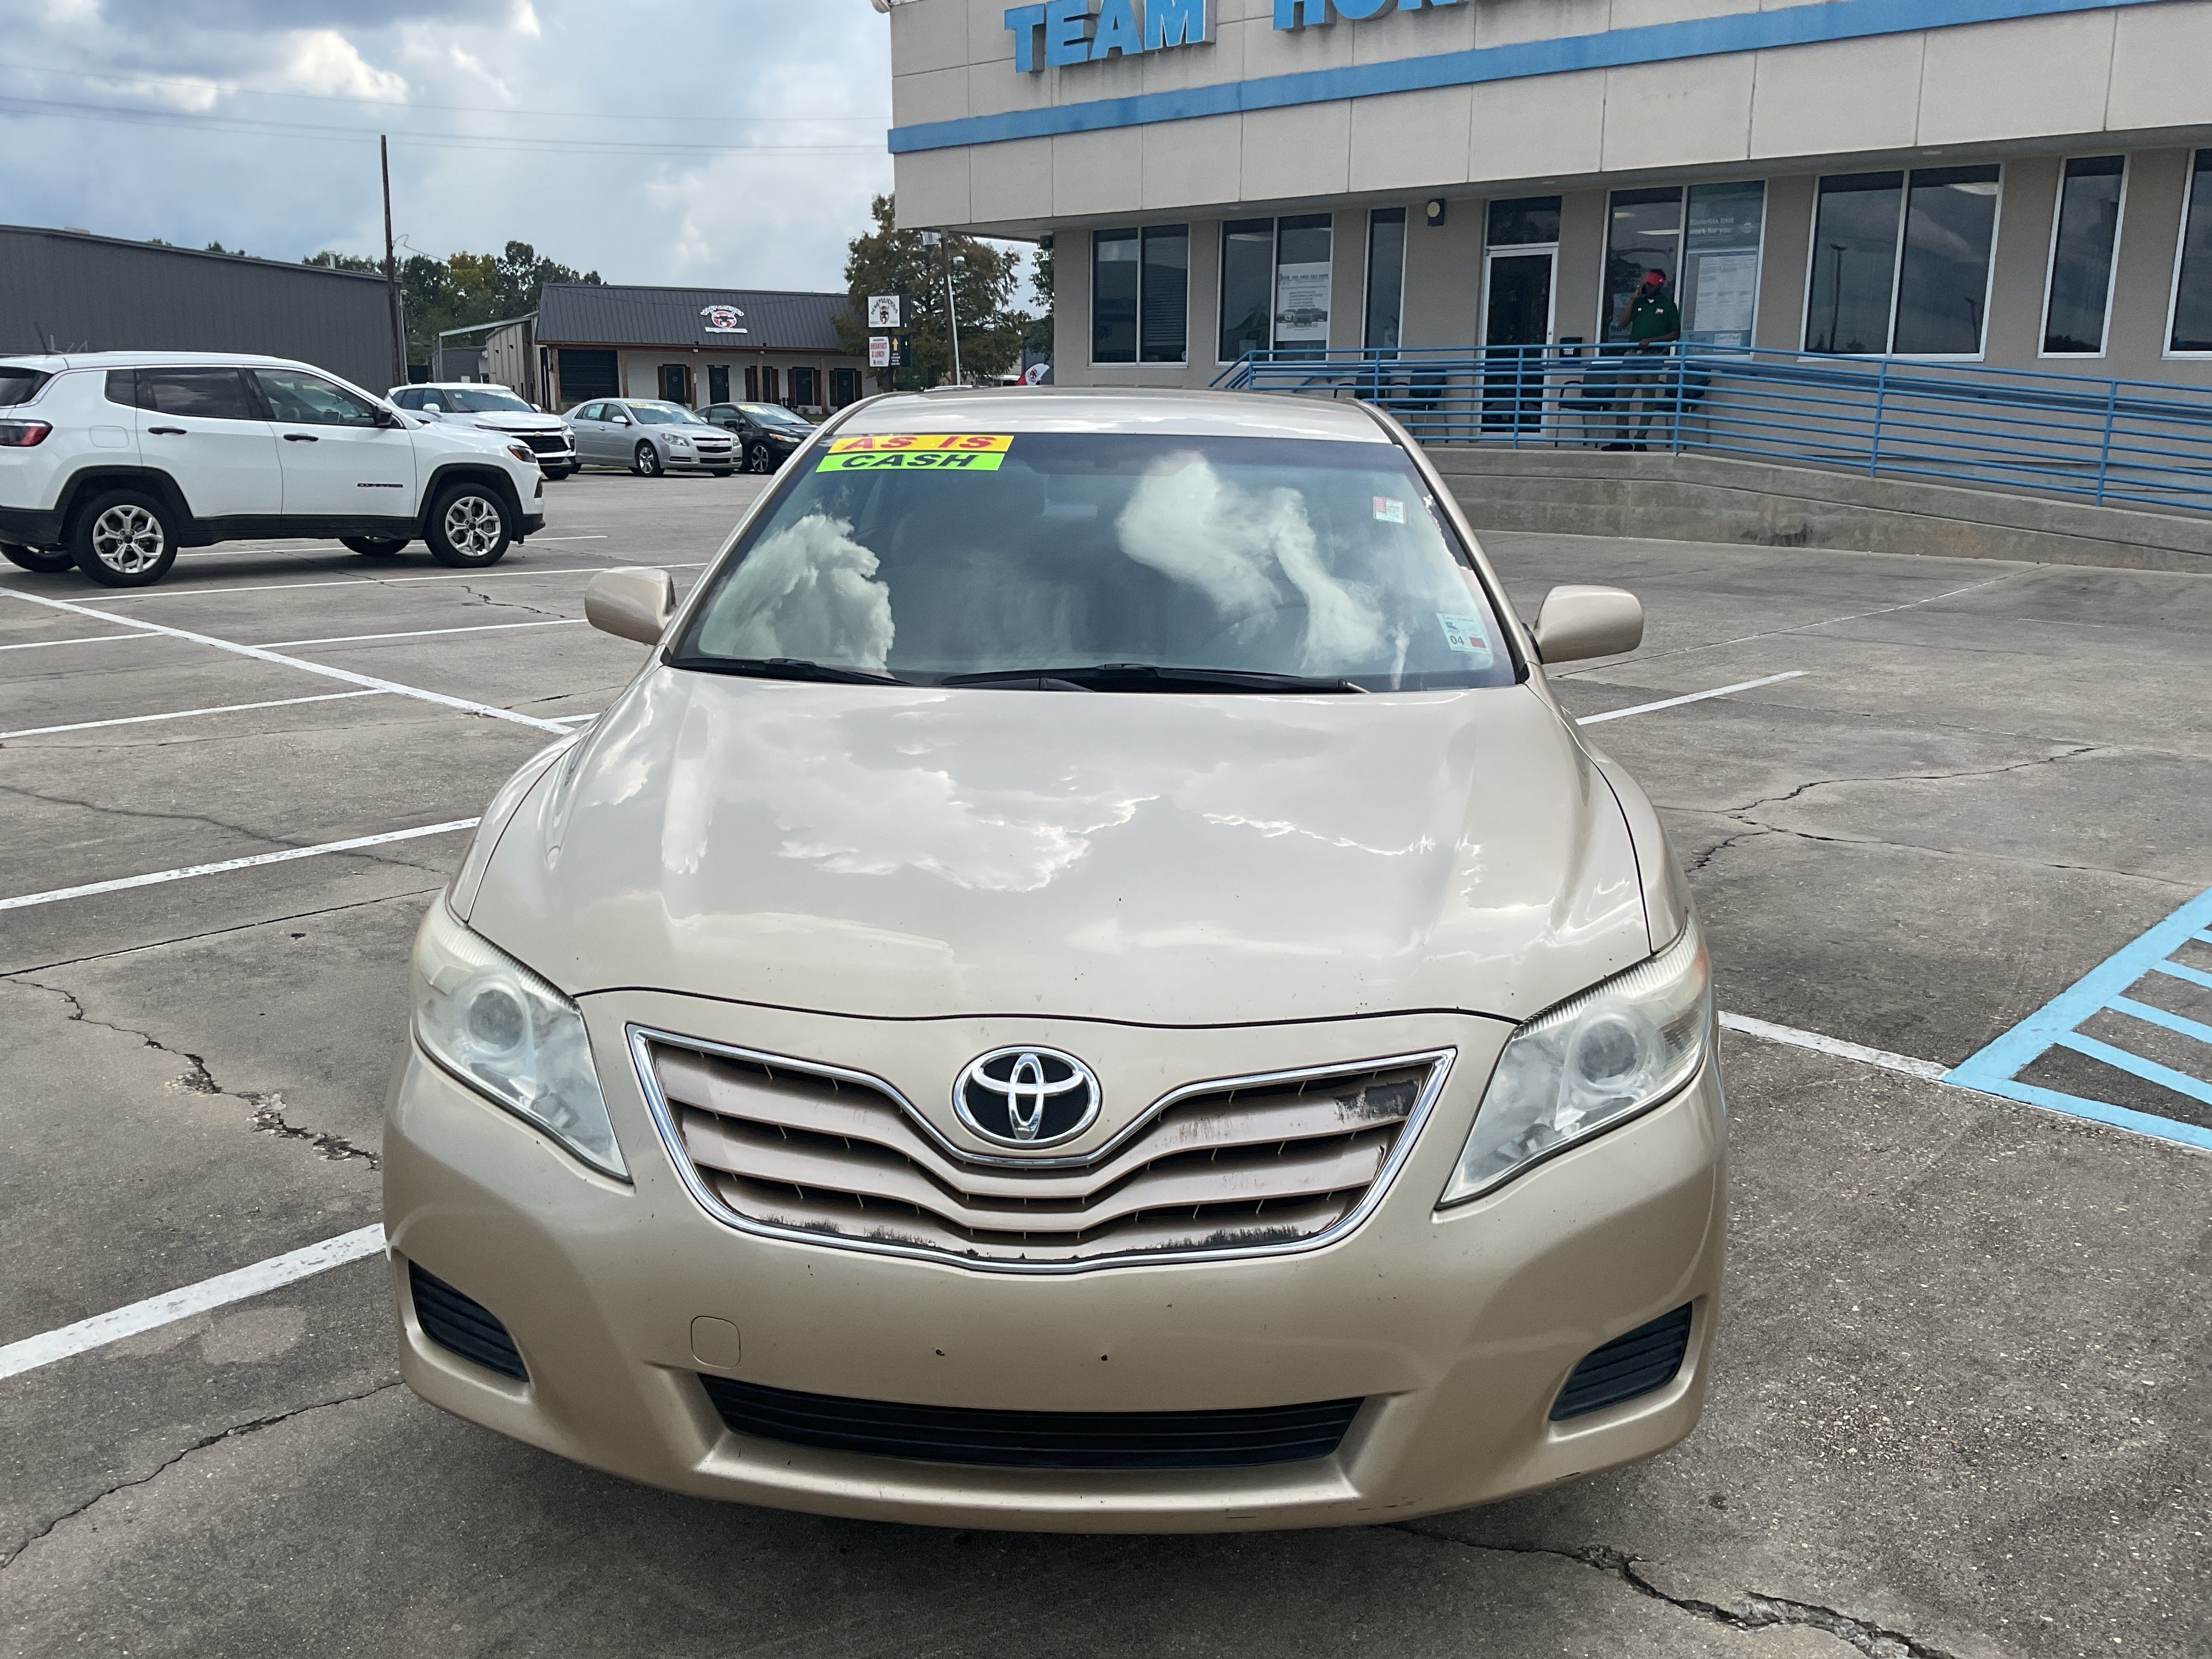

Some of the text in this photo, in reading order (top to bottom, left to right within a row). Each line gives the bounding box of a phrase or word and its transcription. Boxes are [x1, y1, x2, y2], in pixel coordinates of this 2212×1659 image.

[1004, 0, 1207, 74] TEAM
[843, 436, 996, 450] AS IS
[842, 454, 979, 468] CASH
[1450, 635, 1464, 645] 04
